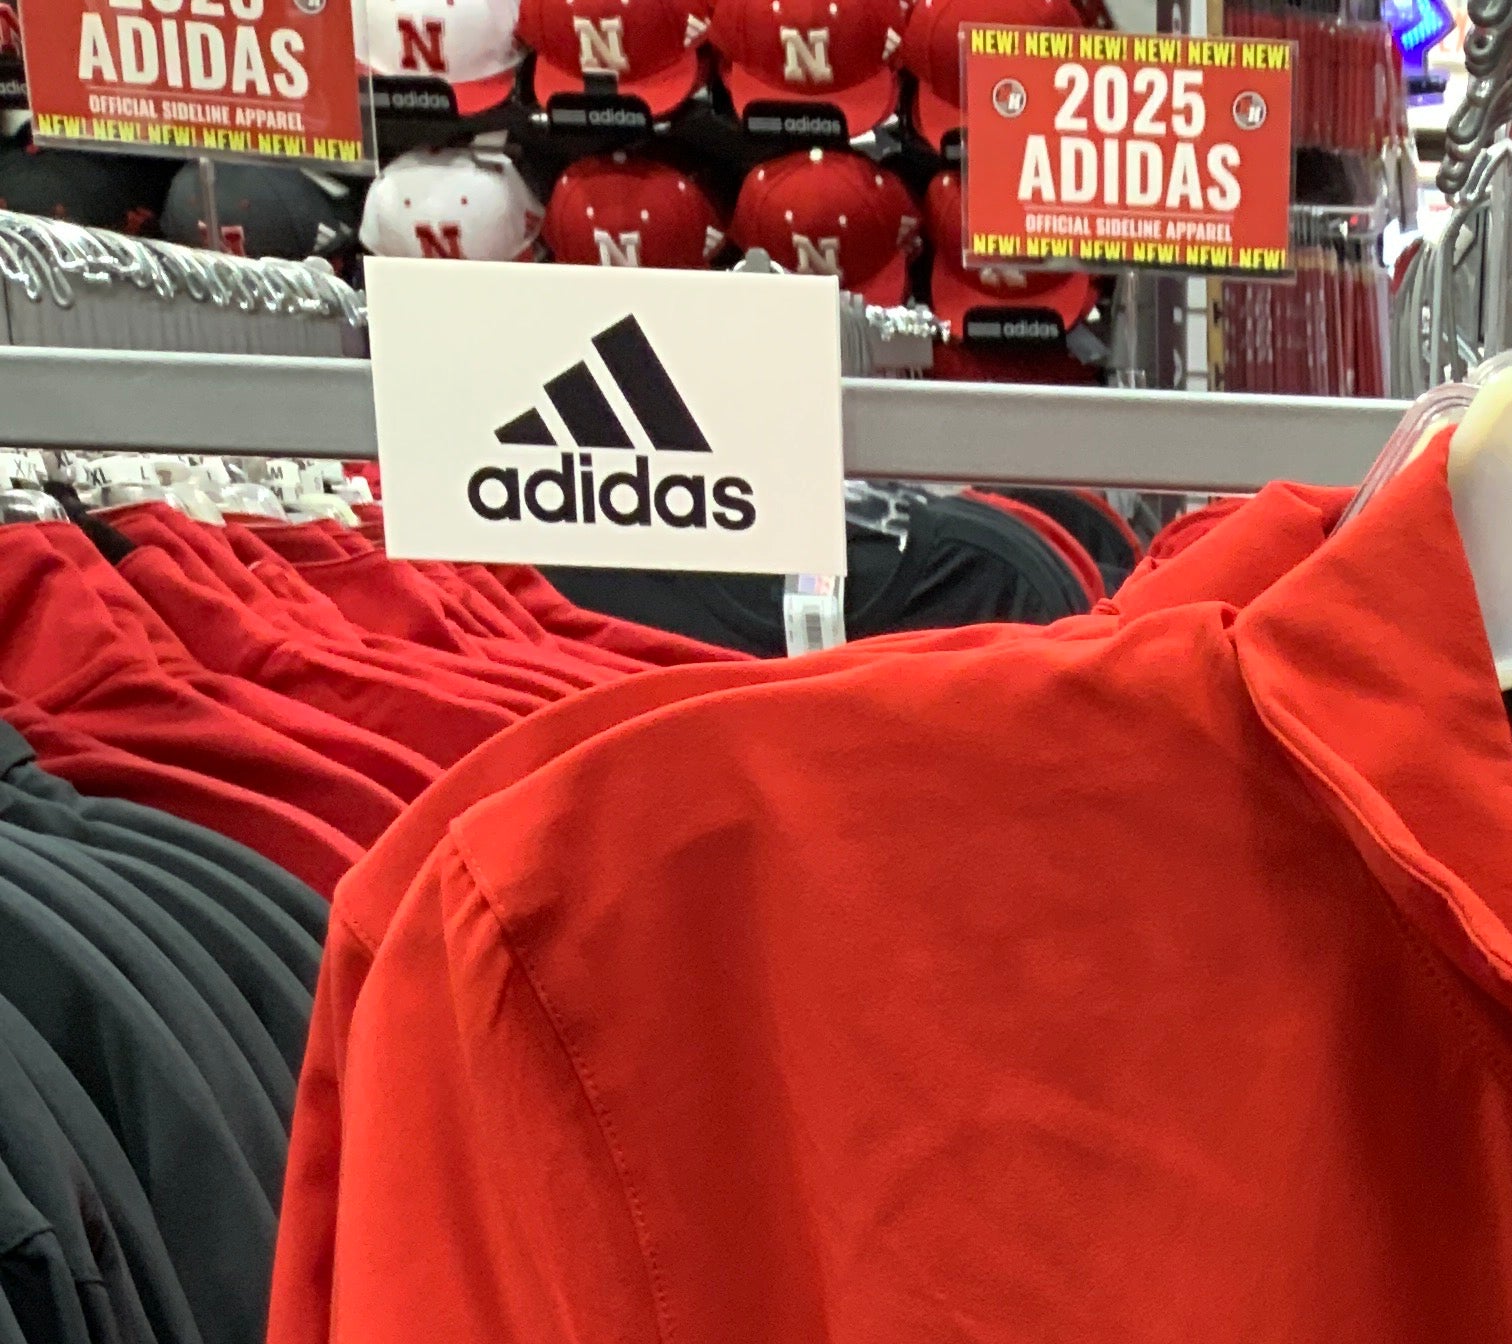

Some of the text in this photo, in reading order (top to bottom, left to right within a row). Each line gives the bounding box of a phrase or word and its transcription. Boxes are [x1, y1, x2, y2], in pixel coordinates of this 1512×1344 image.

[78, 12, 309, 100] ADIDAS
[397, 17, 447, 73] N
[573, 15, 629, 73] N
[780, 26, 834, 83] N
[971, 29, 1290, 70] NEW! NEW! NEW! NEW! NEW! NEW!
[89, 95, 305, 131] OFFICIAL SIDELINE APPAREL
[391, 91, 450, 111] adidas
[589, 106, 647, 127] adidas
[1054, 62, 1206, 138] 2025
[784, 116, 841, 134] adidas
[1018, 134, 1241, 212] ADIDAS
[1025, 214, 1232, 243] OFFICIAL SIDELINE APPAREL
[1003, 320, 1059, 339] adidas
[467, 452, 757, 531] adidas
